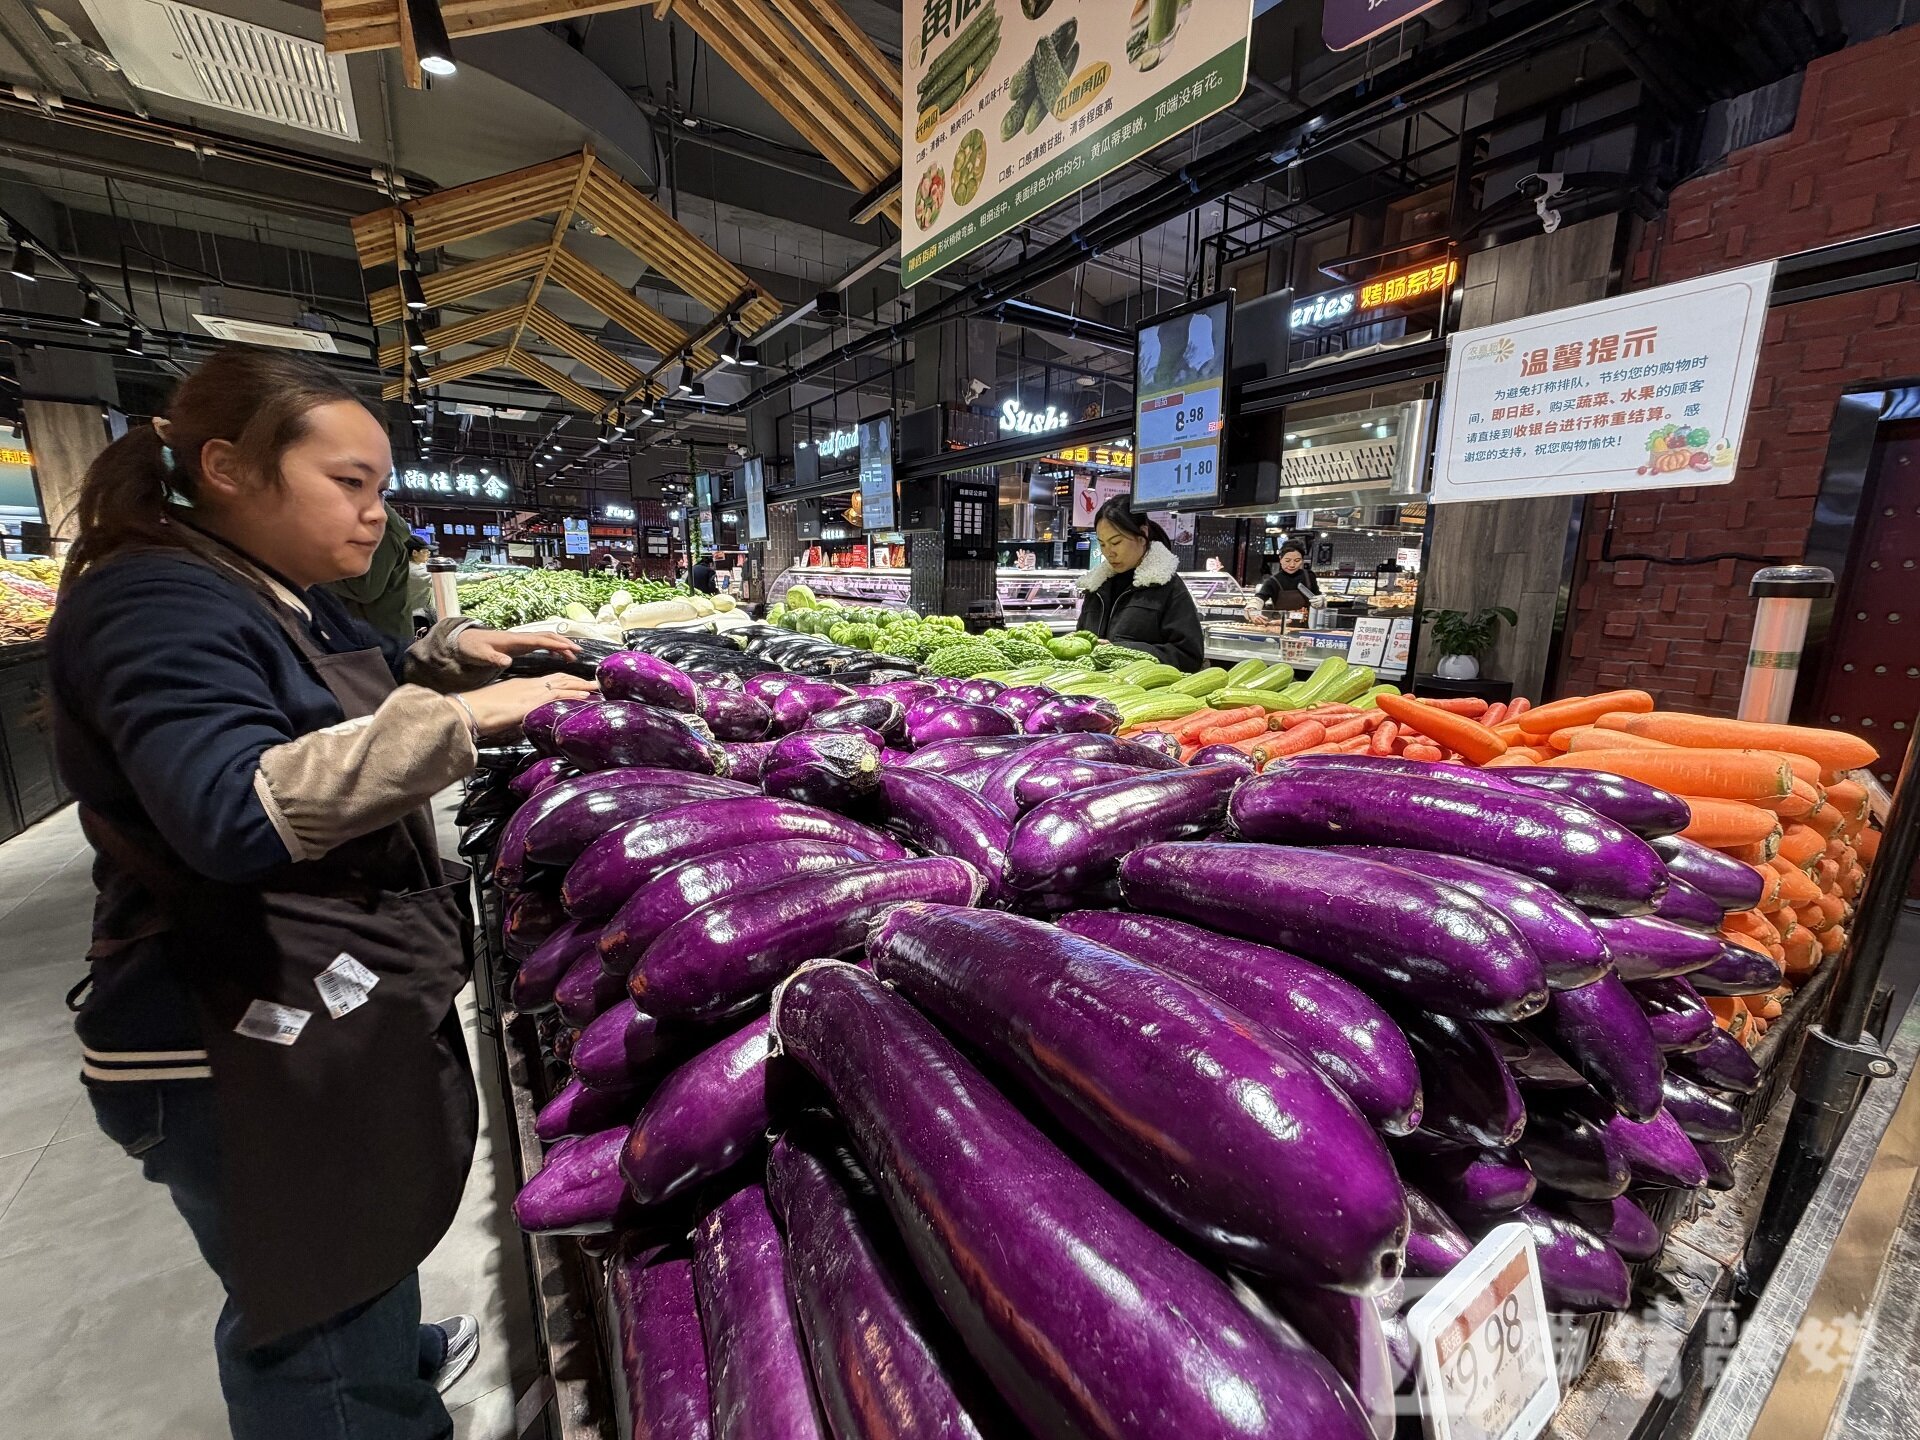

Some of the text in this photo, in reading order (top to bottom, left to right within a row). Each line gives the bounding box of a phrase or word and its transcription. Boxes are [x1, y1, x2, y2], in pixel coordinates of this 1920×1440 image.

[1055, 65, 1107, 116] 本地黄瓜
[1361, 261, 1457, 308] 烤肠系列
[1291, 293, 1354, 328] eries
[1520, 326, 1658, 378] 温馨提示
[1000, 400, 1069, 434] Sushi
[1176, 407, 1204, 432] 8.98
[1174, 460, 1213, 484] 11.80
